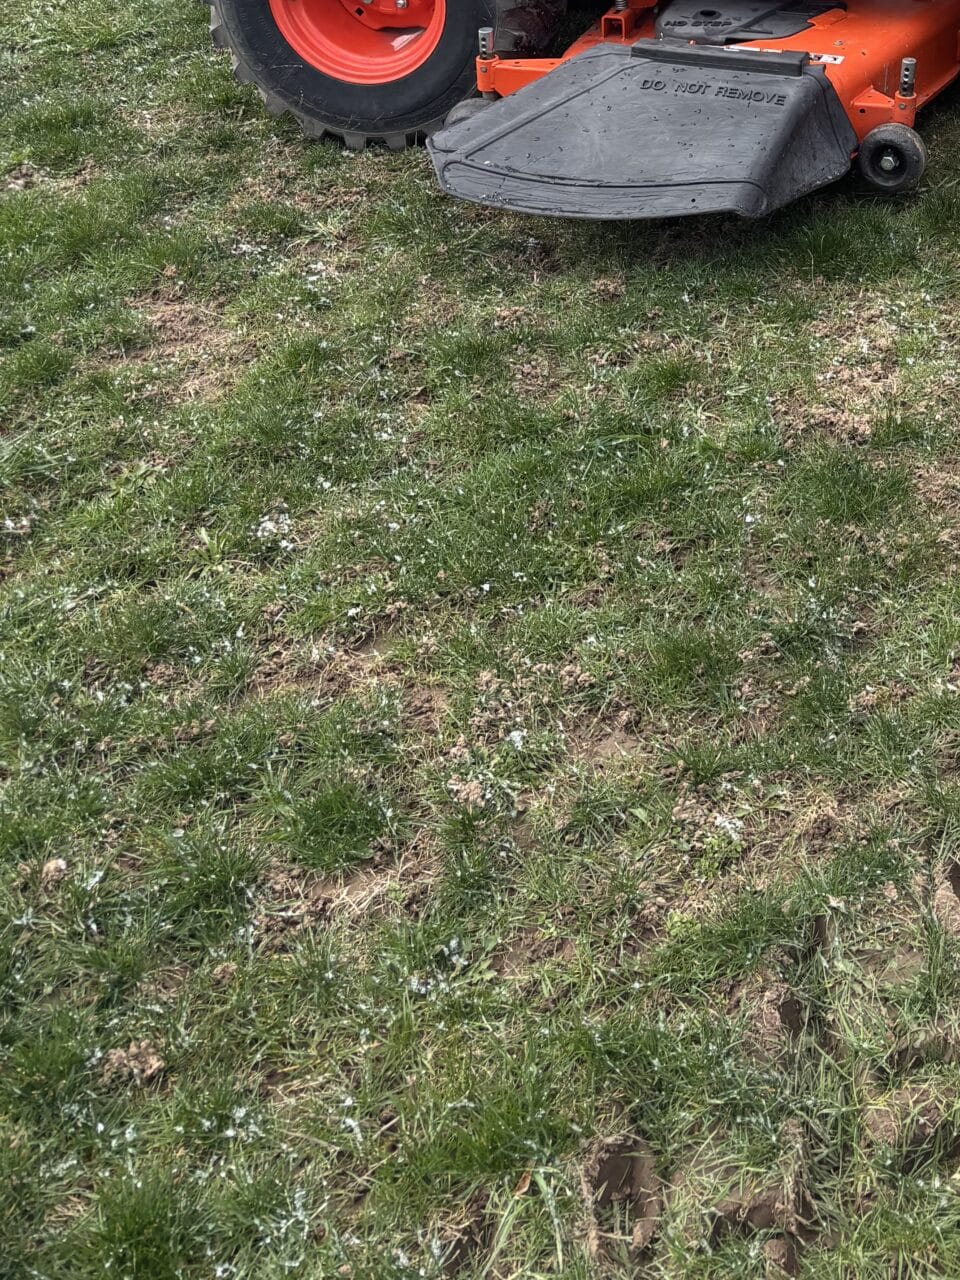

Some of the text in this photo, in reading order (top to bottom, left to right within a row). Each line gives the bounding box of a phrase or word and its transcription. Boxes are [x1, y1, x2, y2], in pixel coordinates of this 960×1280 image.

[640, 79, 787, 106] DO NOT REMOVE
